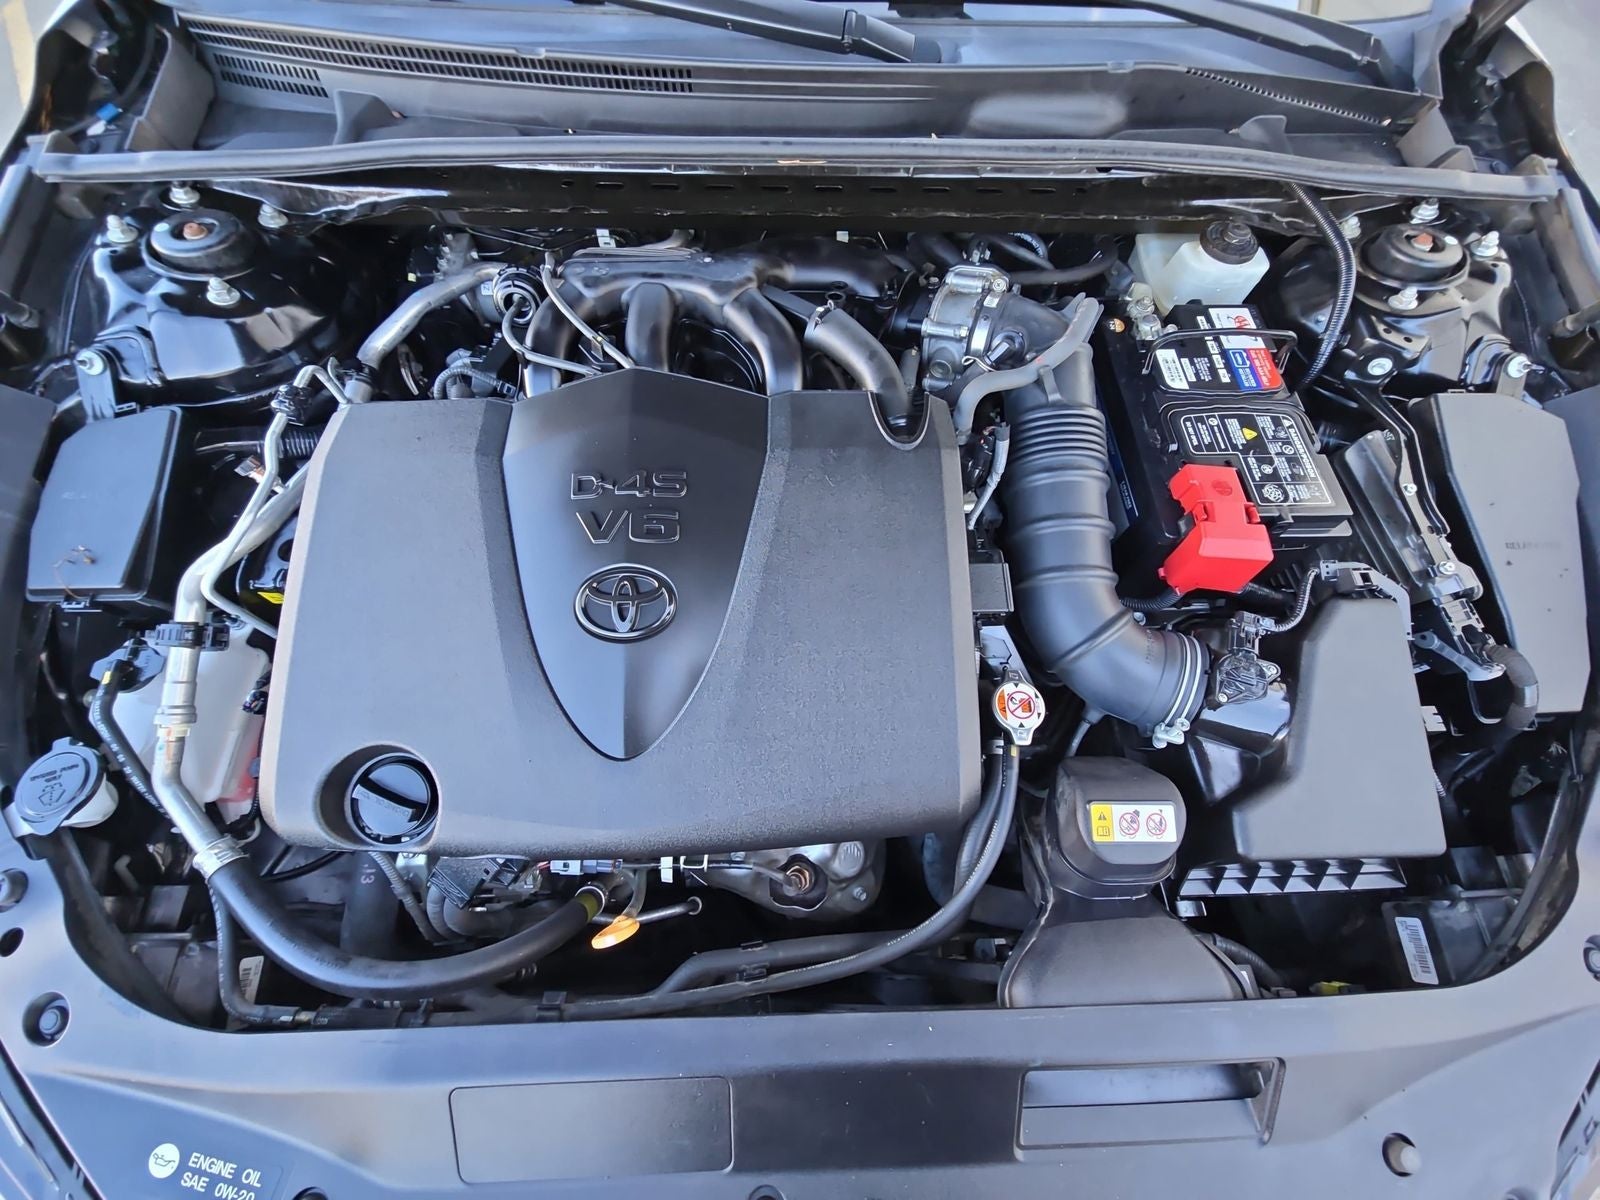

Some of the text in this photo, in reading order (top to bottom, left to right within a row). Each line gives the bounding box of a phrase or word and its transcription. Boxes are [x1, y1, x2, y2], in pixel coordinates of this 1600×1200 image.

[1289, 428, 1317, 478] DANGER/POISON
[571, 470, 687, 499] D-4S
[576, 510, 680, 544] V6
[181, 1172, 256, 1200] SAE 0W-20
[188, 1152, 262, 1188] ENGINE OIL
